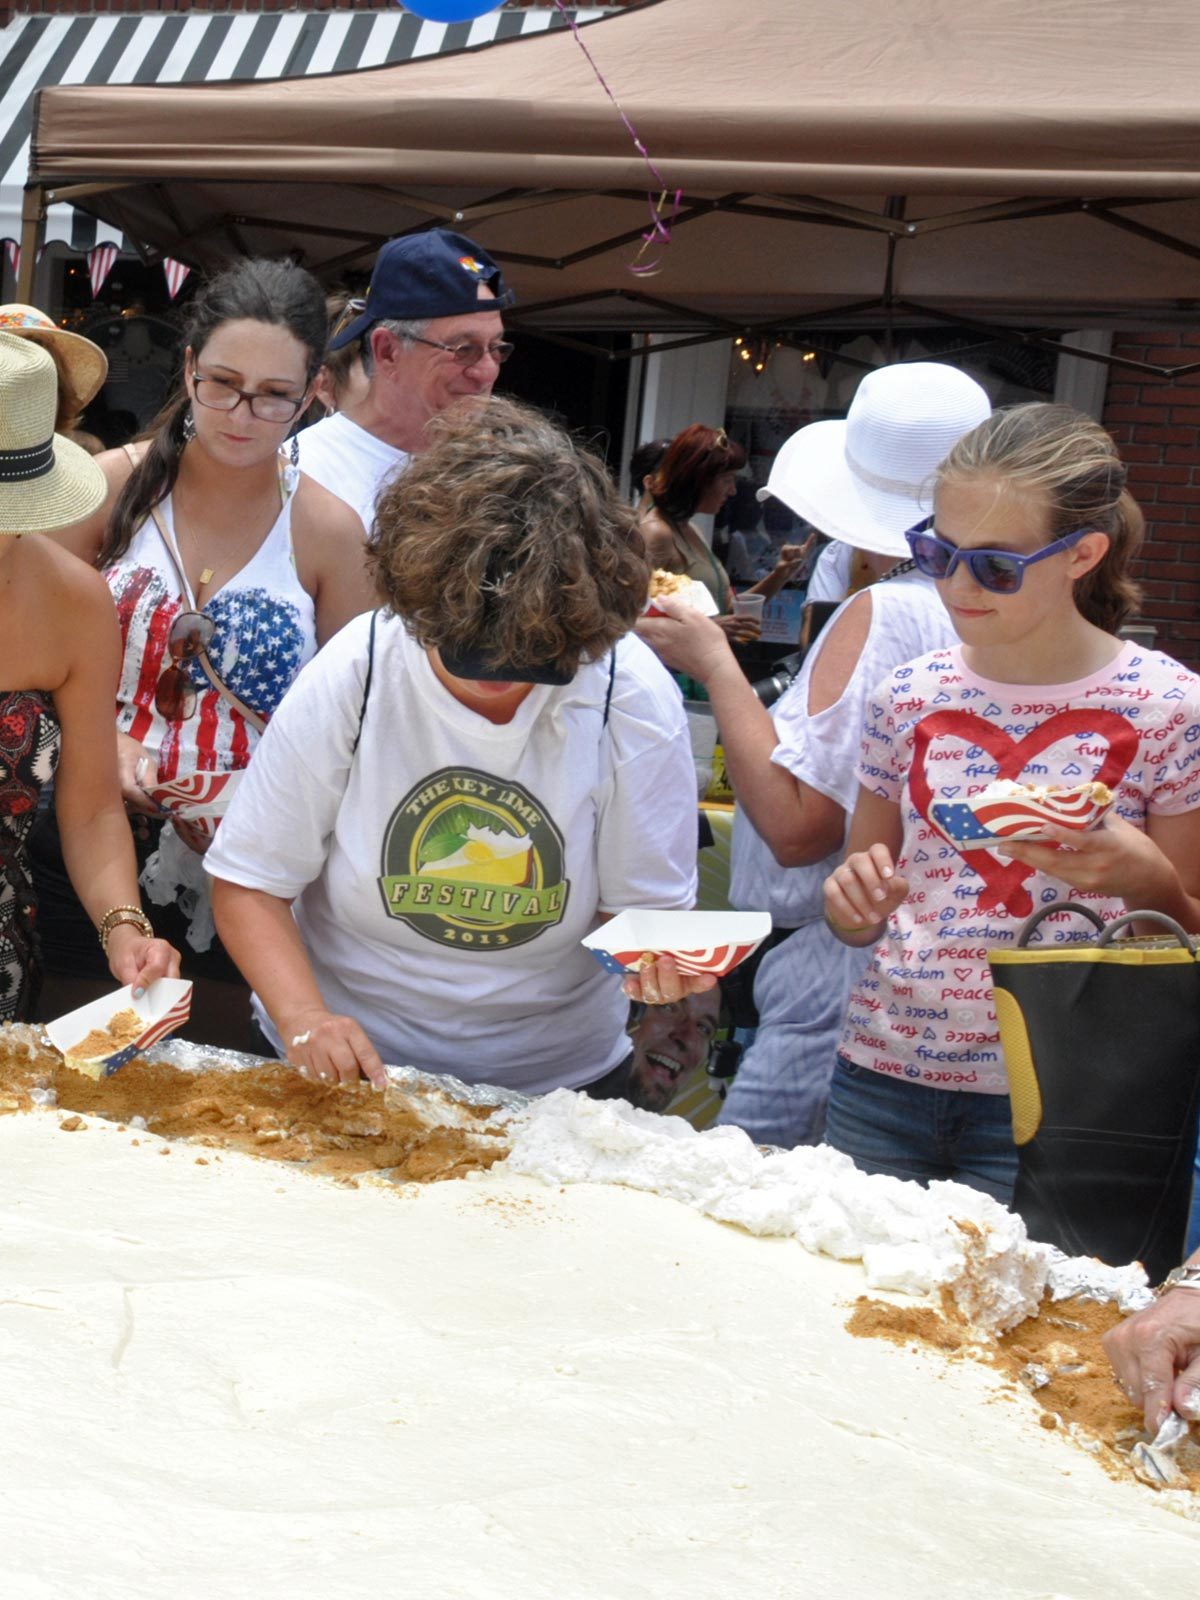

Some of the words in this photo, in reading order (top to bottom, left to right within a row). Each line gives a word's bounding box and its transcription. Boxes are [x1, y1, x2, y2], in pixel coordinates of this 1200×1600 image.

[405, 779, 451, 817] THE
[389, 882, 562, 917] FESTIVAL
[443, 928, 510, 945] 2013
[936, 923, 1016, 941] freedom
[937, 947, 988, 961] peace
[940, 987, 994, 1001] peace
[904, 1005, 949, 1020] peace
[944, 1030, 1001, 1044] peace
[914, 1045, 999, 1062] freedom
[923, 1070, 978, 1083] peace
